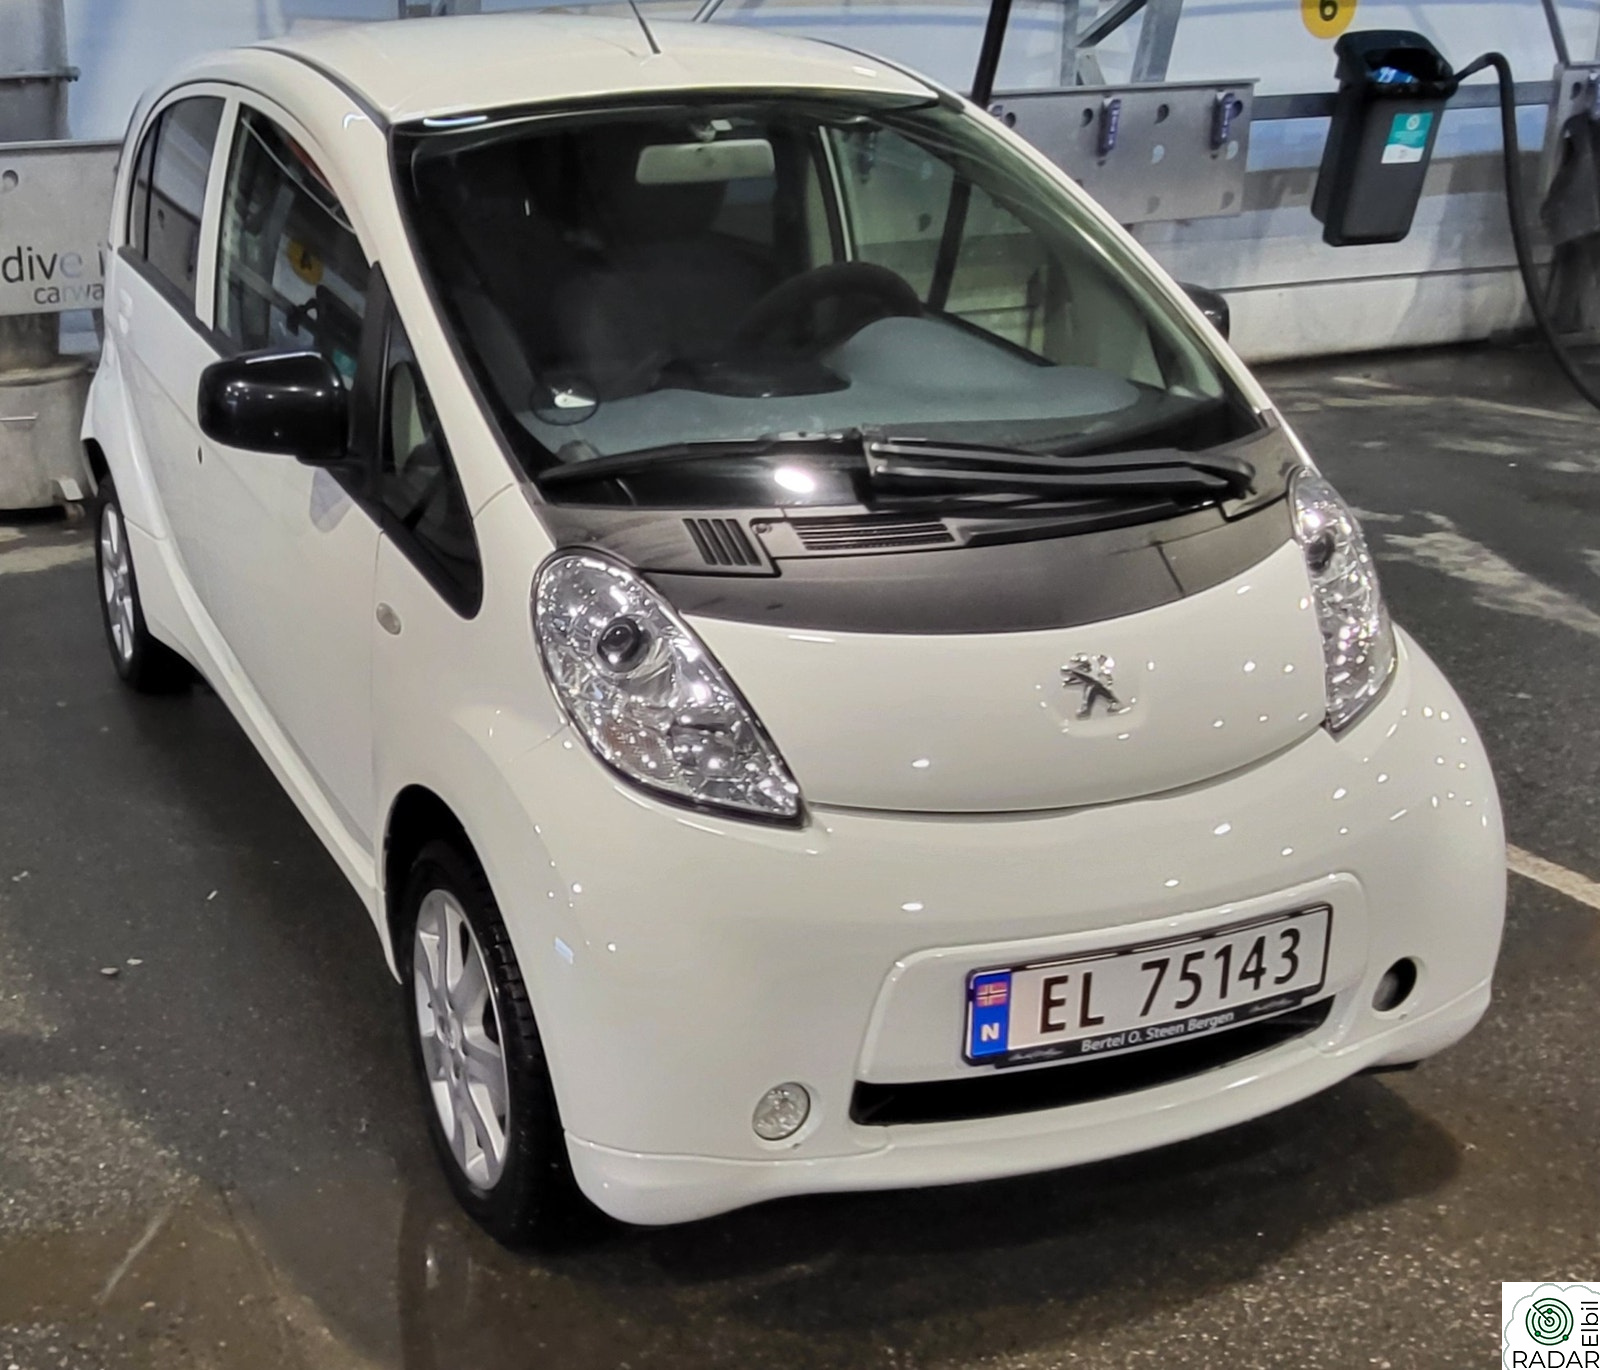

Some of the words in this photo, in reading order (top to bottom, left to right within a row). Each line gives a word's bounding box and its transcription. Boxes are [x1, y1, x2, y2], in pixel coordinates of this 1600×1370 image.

[1319, 0, 1338, 21] 6
[2, 245, 82, 283] dive
[97, 242, 105, 277] i
[34, 283, 105, 305] carwa
[1040, 972, 1104, 1034] EL
[1140, 928, 1300, 1018] 75143
[981, 1022, 999, 1042] N
[1081, 1035, 1125, 1052] Bertel
[1128, 1030, 1142, 1043] O.
[1146, 1023, 1185, 1040] Steen
[1188, 1012, 1235, 1032] Bergen
